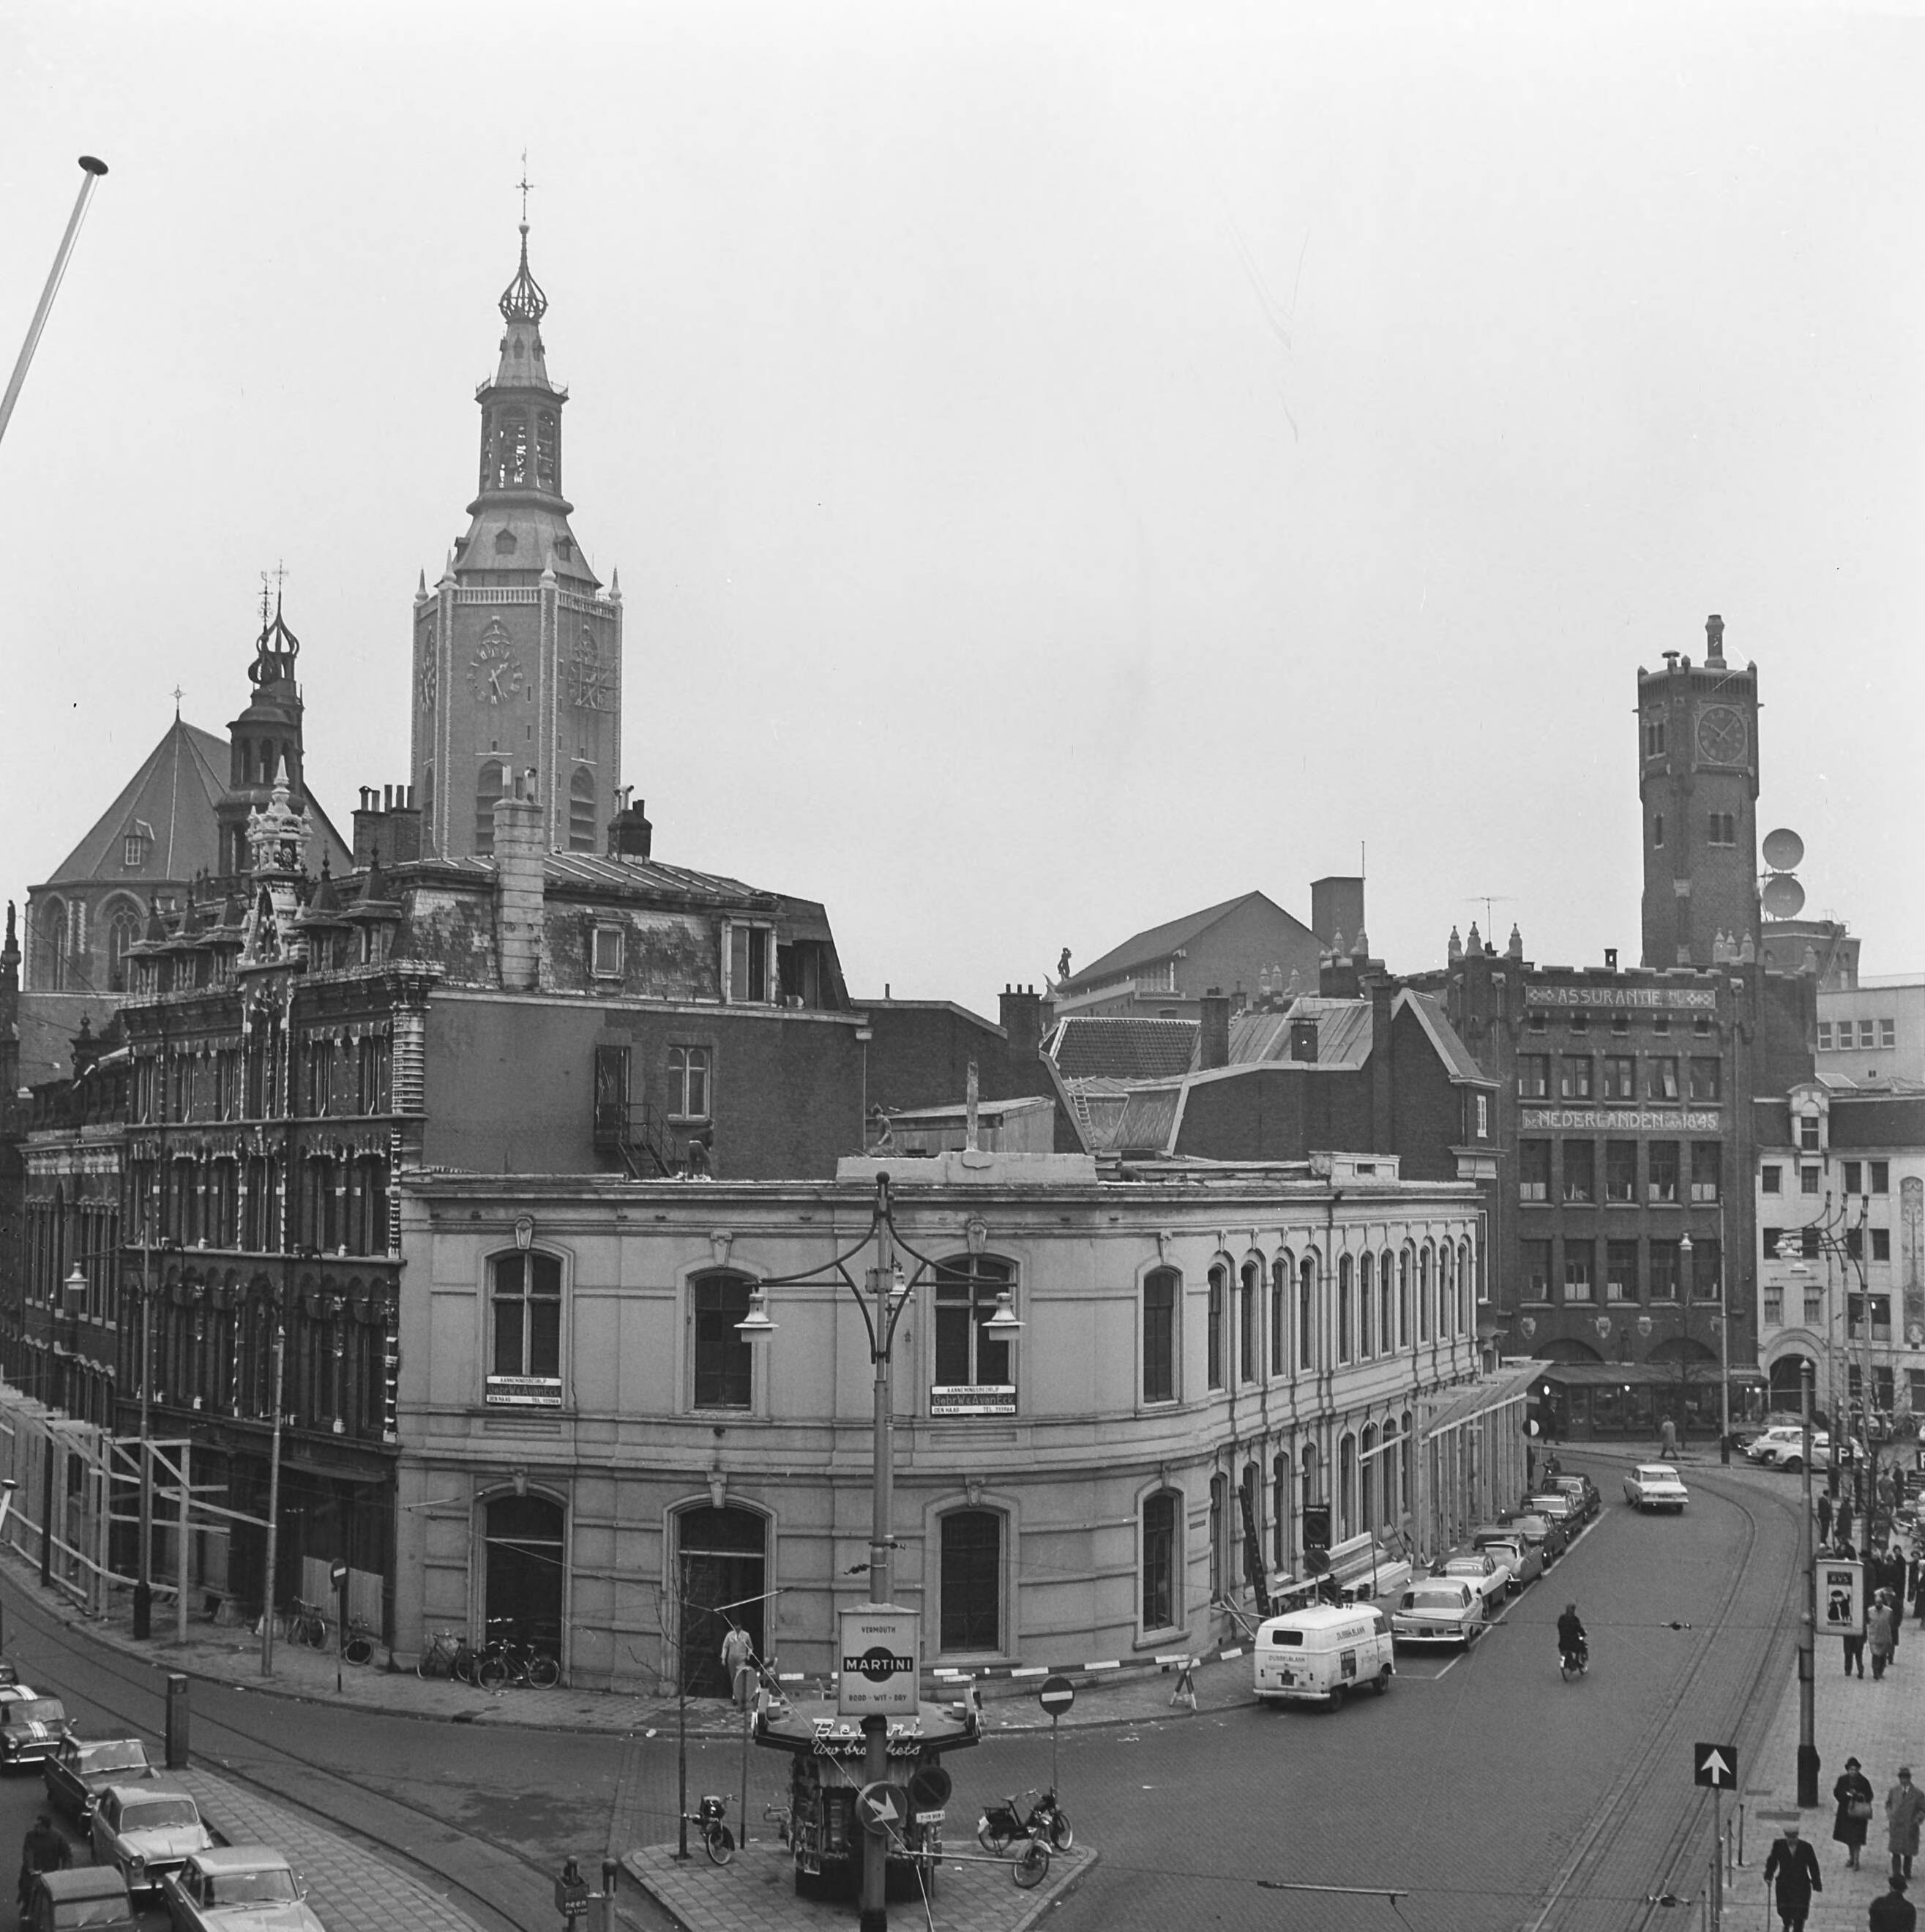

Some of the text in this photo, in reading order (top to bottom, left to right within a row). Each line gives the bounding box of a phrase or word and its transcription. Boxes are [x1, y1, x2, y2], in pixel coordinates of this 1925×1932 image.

[1558, 989, 1662, 1006] ASSURANTIE
[1539, 1111, 1664, 1128] NEDERLANDEN
[1683, 1112, 1717, 1128] 1845
[1839, 1448, 1850, 1464] P
[846, 1659, 911, 1670] MARTINI
